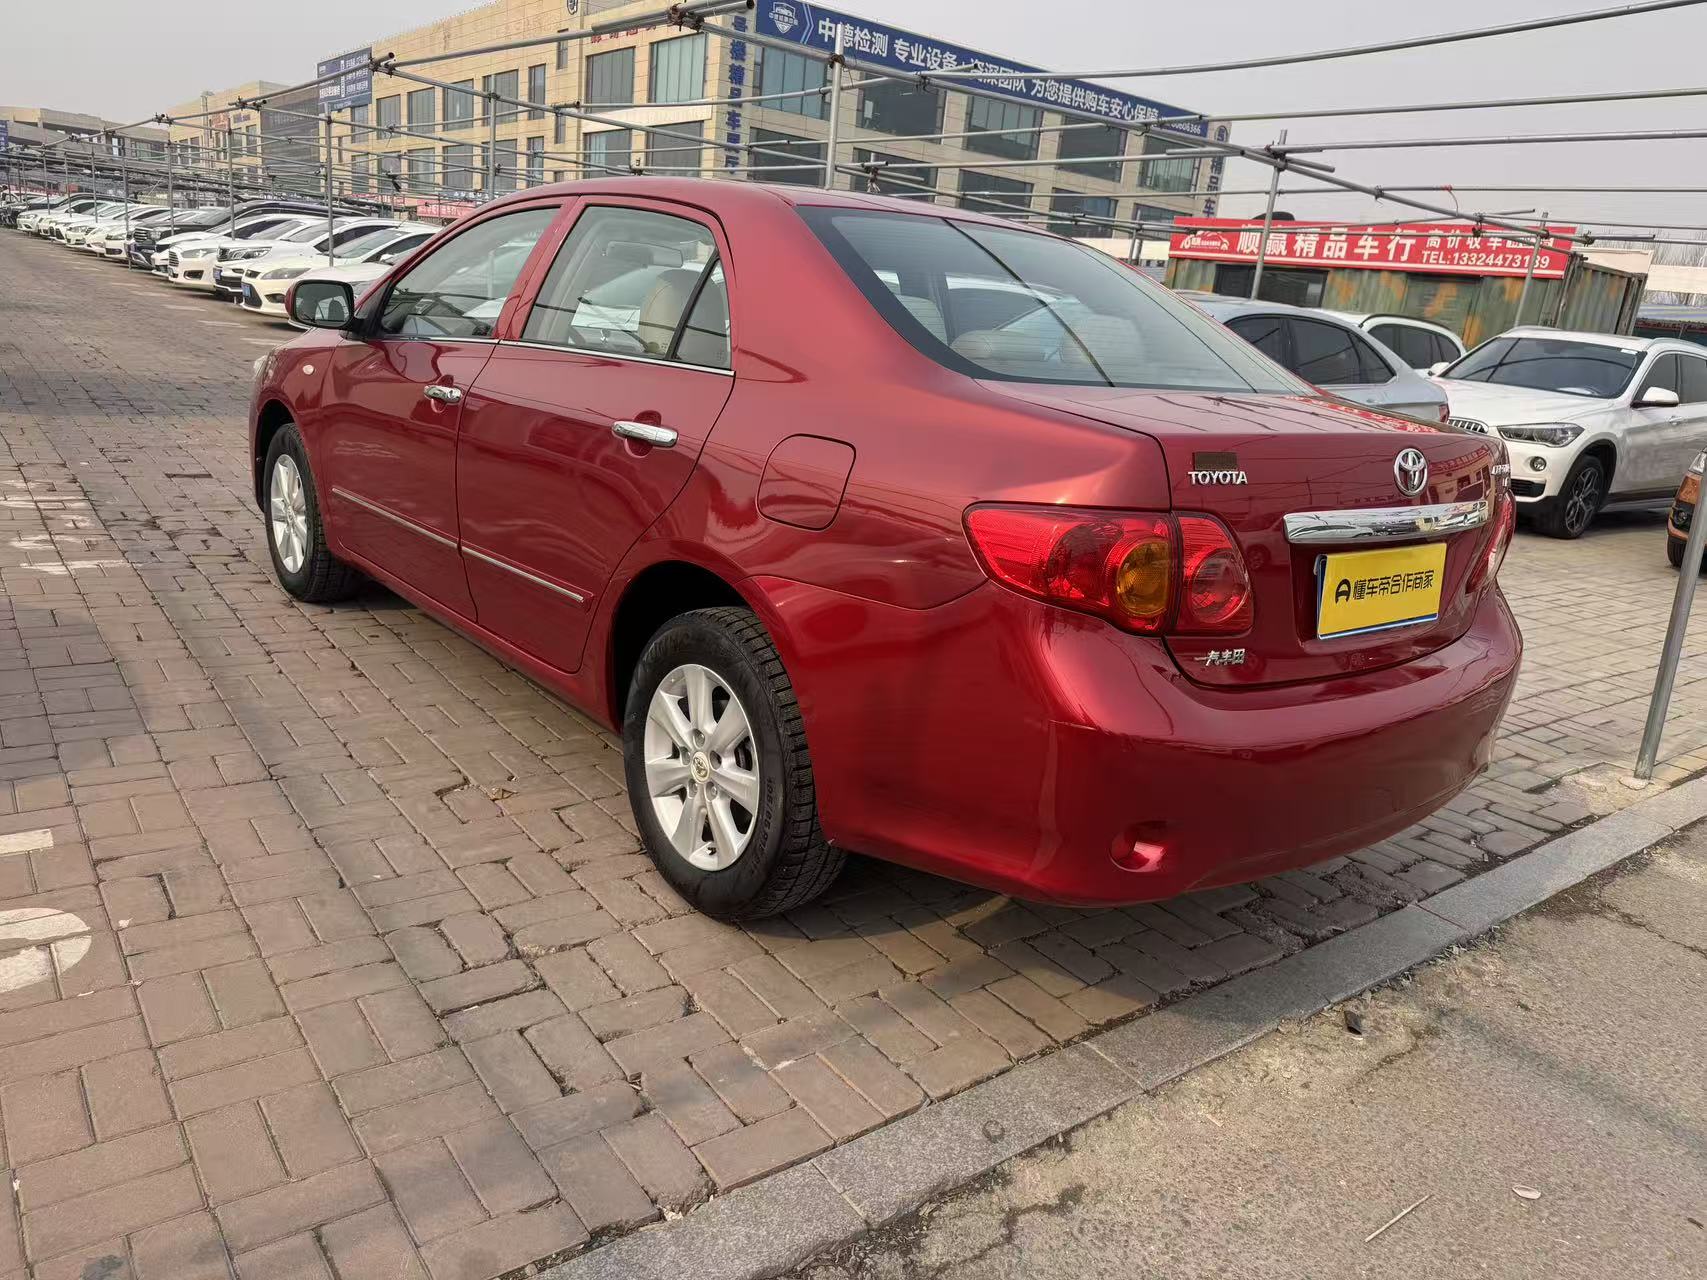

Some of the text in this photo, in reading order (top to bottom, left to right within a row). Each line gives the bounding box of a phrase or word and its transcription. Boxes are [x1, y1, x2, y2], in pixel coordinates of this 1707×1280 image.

[818, 17, 889, 58] 中德检测
[1030, 78, 1160, 122] 为您提供购车安心保障
[1236, 224, 1417, 262] 顺赢精品车行
[1187, 470, 1248, 485] TOYOTA
[1353, 569, 1434, 600] 懂车帝合作商家
